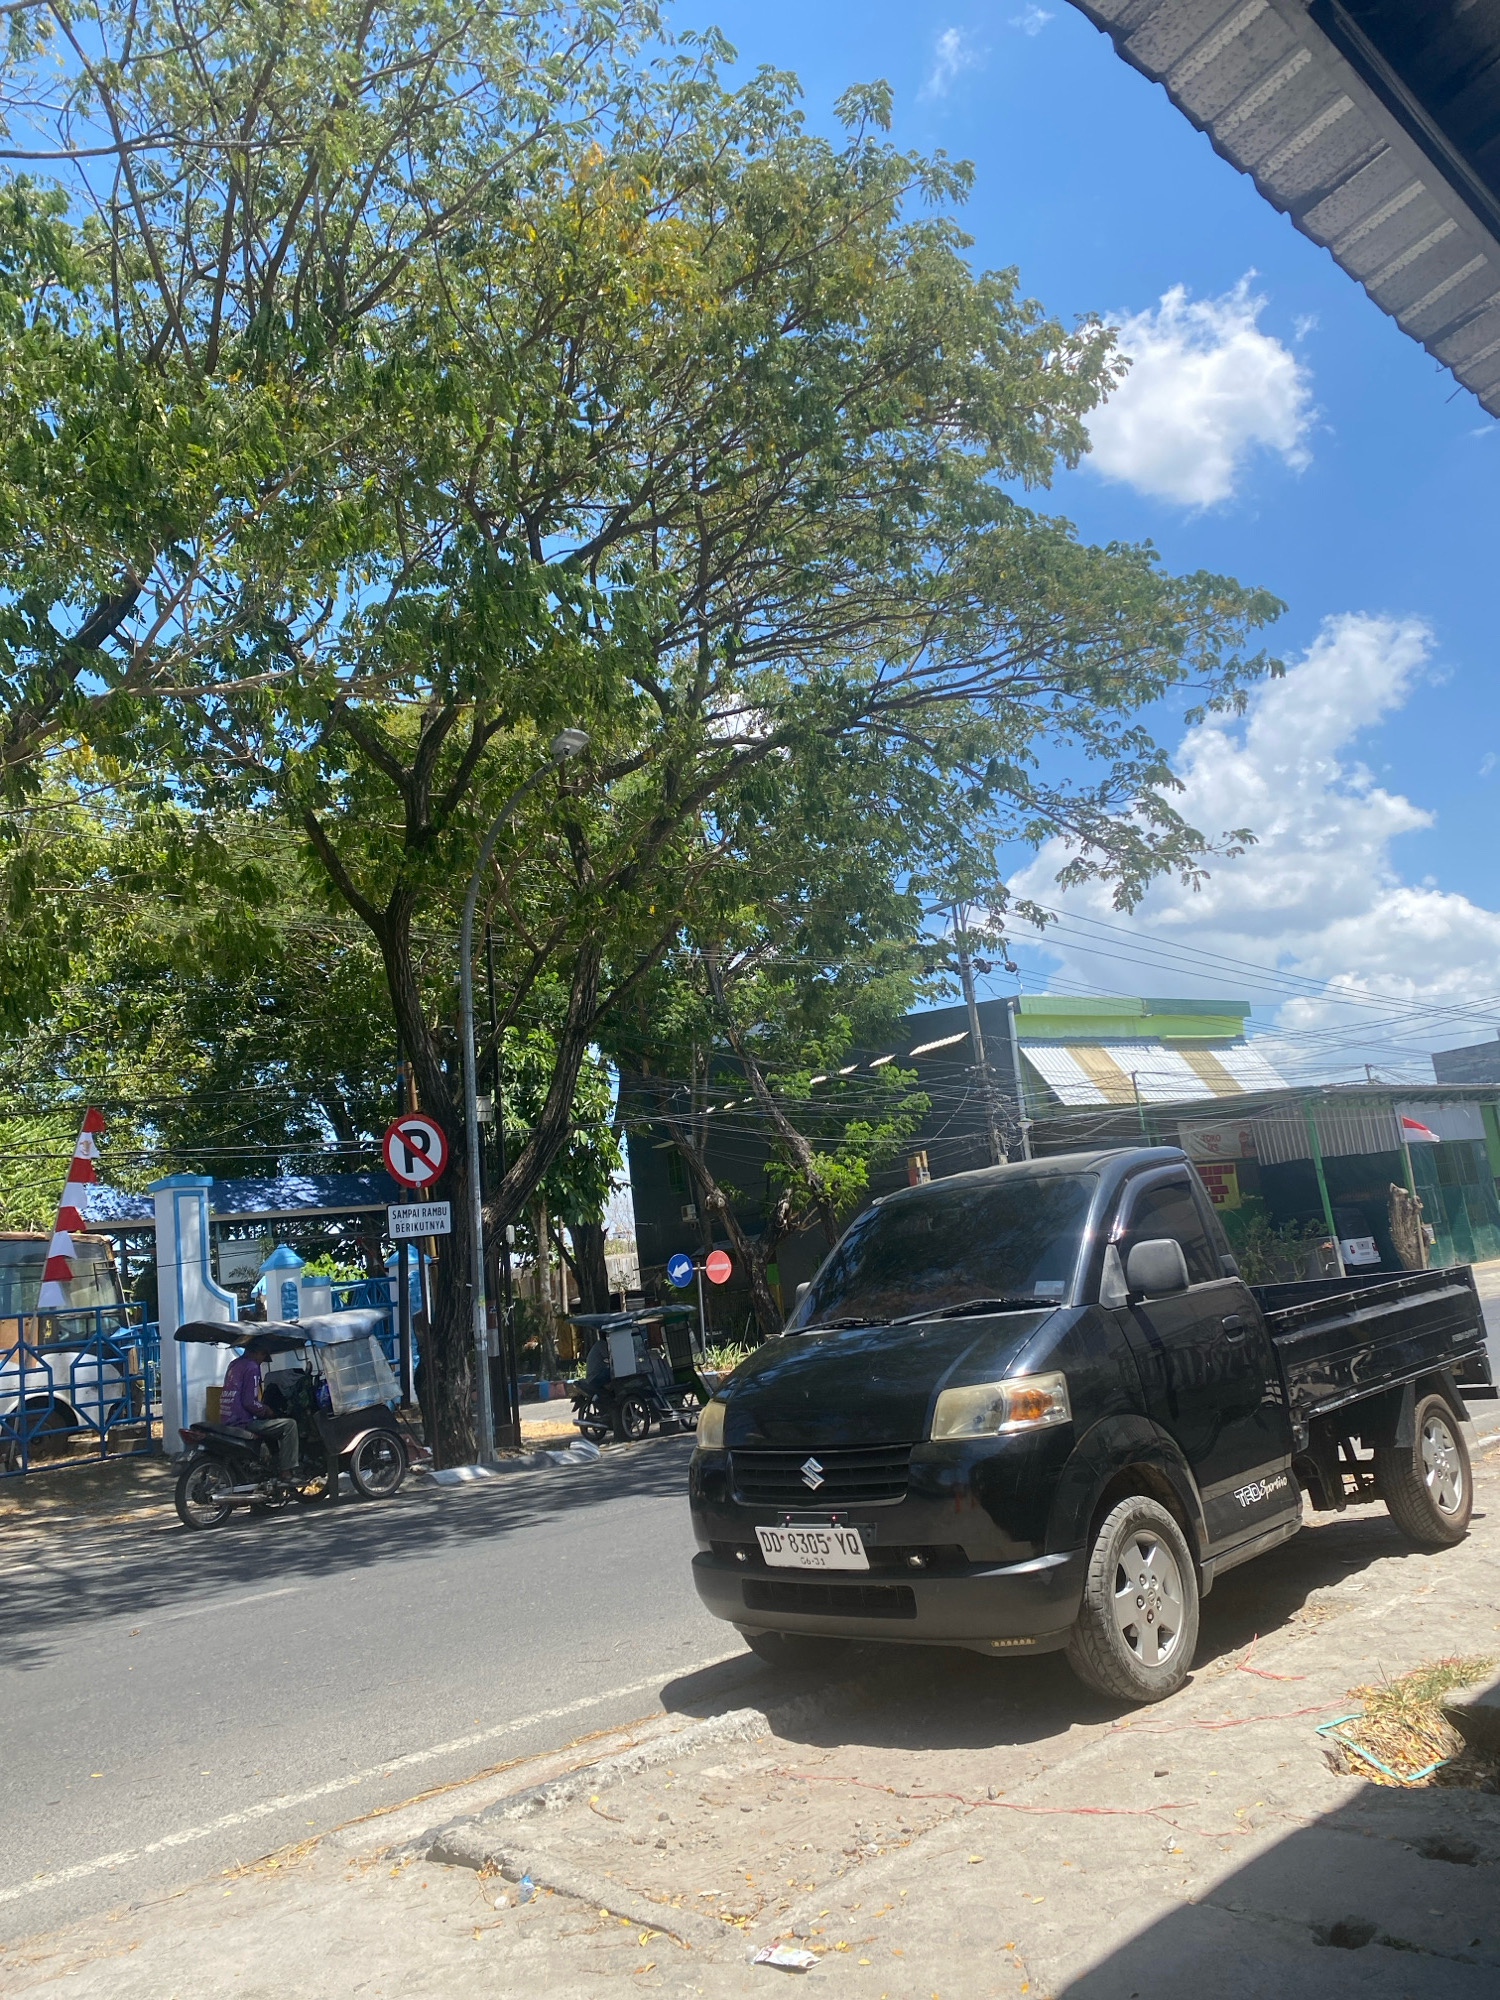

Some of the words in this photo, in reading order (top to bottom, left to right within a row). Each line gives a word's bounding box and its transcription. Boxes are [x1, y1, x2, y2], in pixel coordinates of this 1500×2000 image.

[392, 1208, 420, 1220] SAMPAI
[421, 1206, 448, 1218] RAMBU
[395, 1221, 445, 1233] BERIKUTNYA
[760, 1531, 782, 1553] DD
[788, 1533, 830, 1555] 8305
[834, 1533, 861, 1555] YQ
